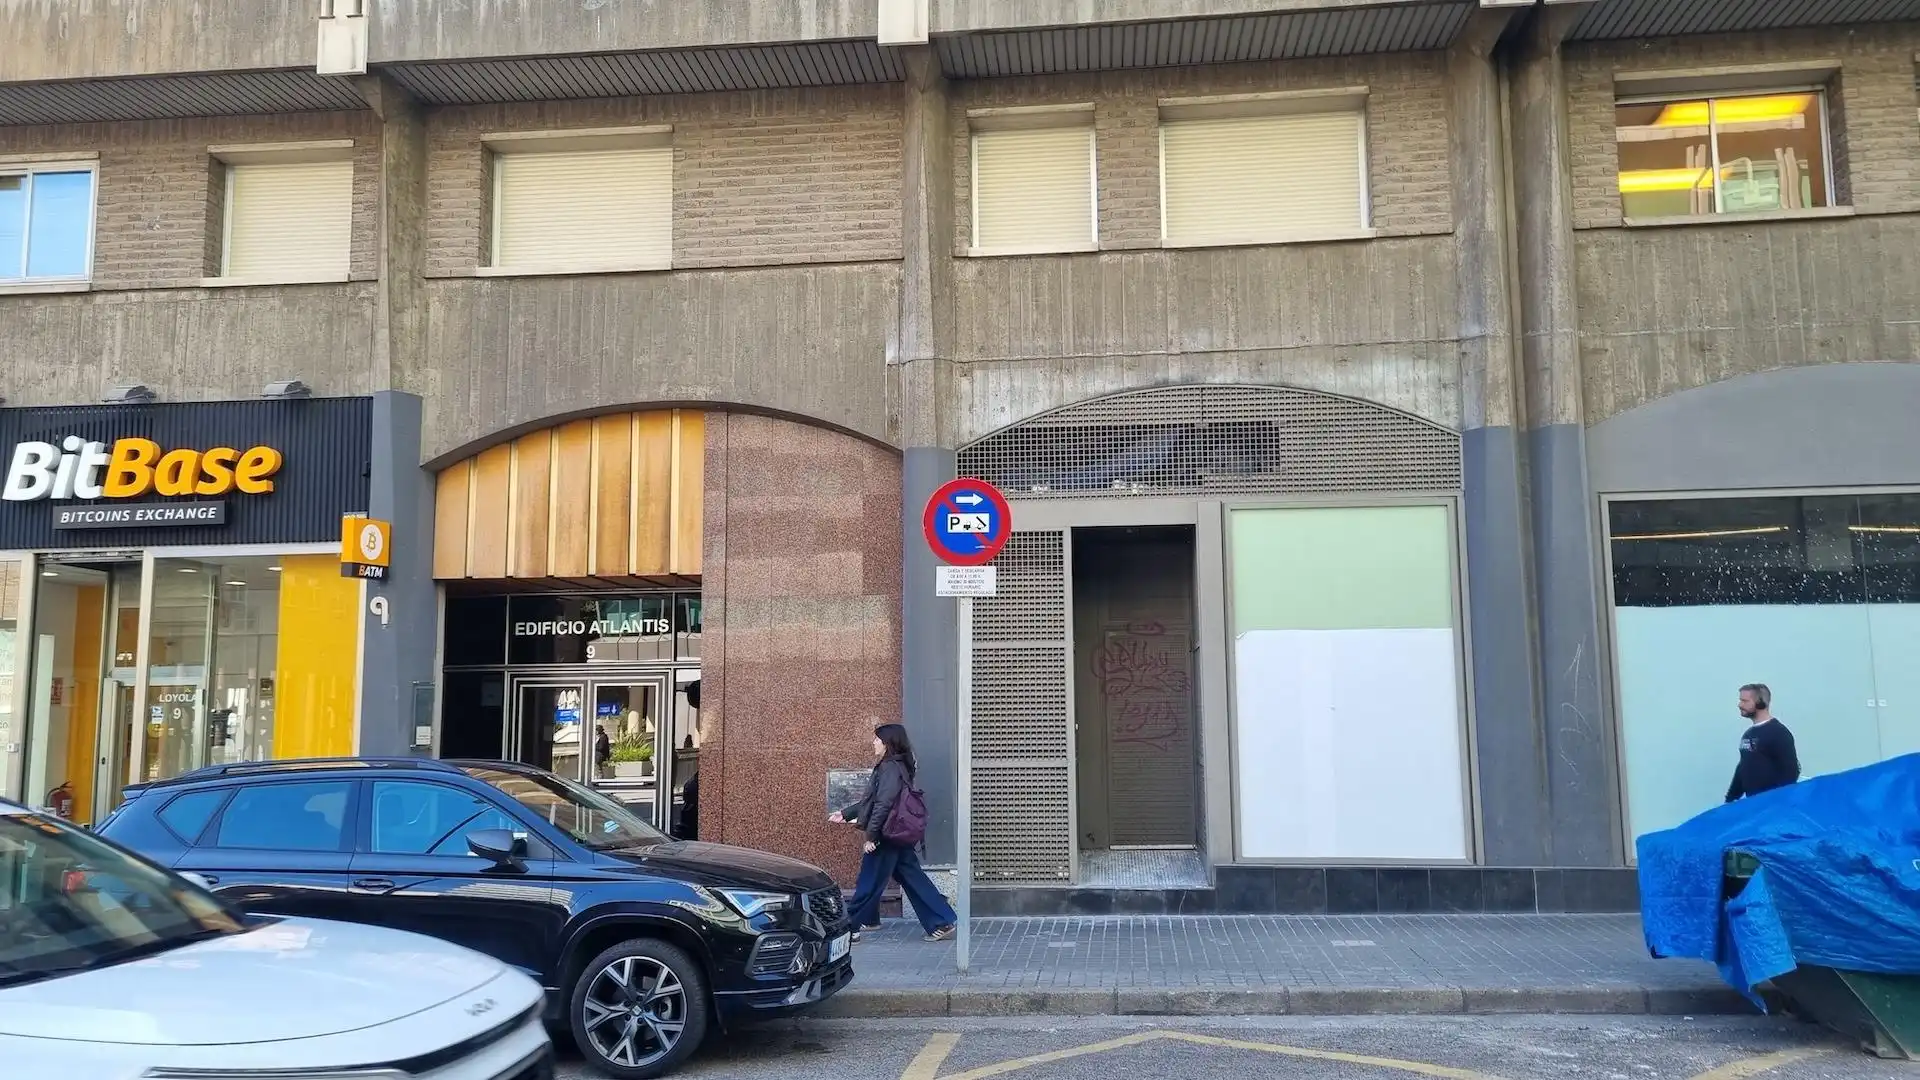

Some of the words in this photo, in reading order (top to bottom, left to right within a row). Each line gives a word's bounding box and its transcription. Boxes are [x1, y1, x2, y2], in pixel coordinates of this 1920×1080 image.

[2, 435, 282, 501] BitBase
[61, 508, 131, 524] BITCOINS
[135, 506, 217, 521] EXCHANGE
[950, 517, 960, 530] P
[358, 566, 383, 577] BATM
[369, 595, 389, 625] 9
[514, 620, 586, 636] EDIFICIO
[588, 618, 670, 634] ATLANTIS
[586, 645, 595, 658] 9
[159, 693, 197, 703] LOYOLA
[173, 708, 181, 719] 9
